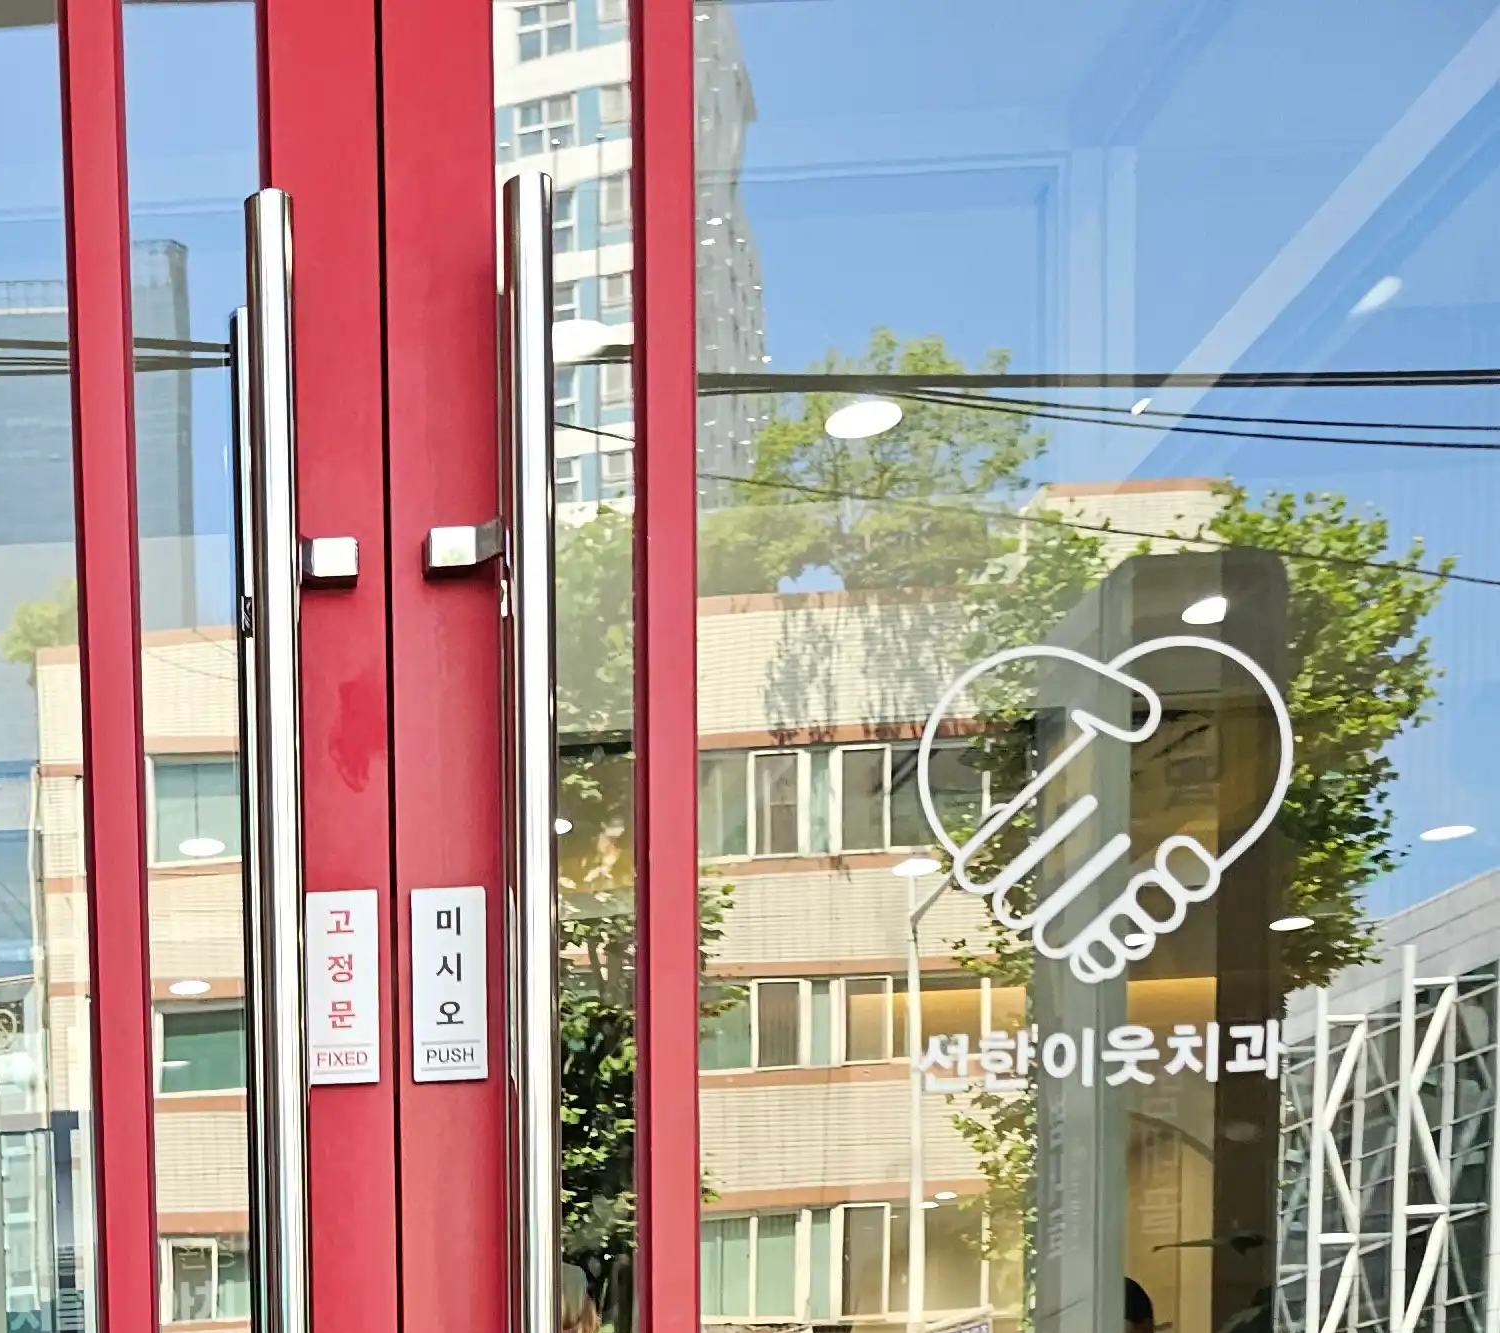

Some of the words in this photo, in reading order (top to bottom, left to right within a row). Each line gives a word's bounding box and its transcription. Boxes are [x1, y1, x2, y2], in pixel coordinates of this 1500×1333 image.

[326, 909, 356, 1029] 고정문
[436, 906, 464, 1026] 미시오
[317, 1051, 368, 1067] FIXED
[427, 1048, 474, 1064] PUSH
[920, 1019, 1290, 1093] 선한이웃치과
